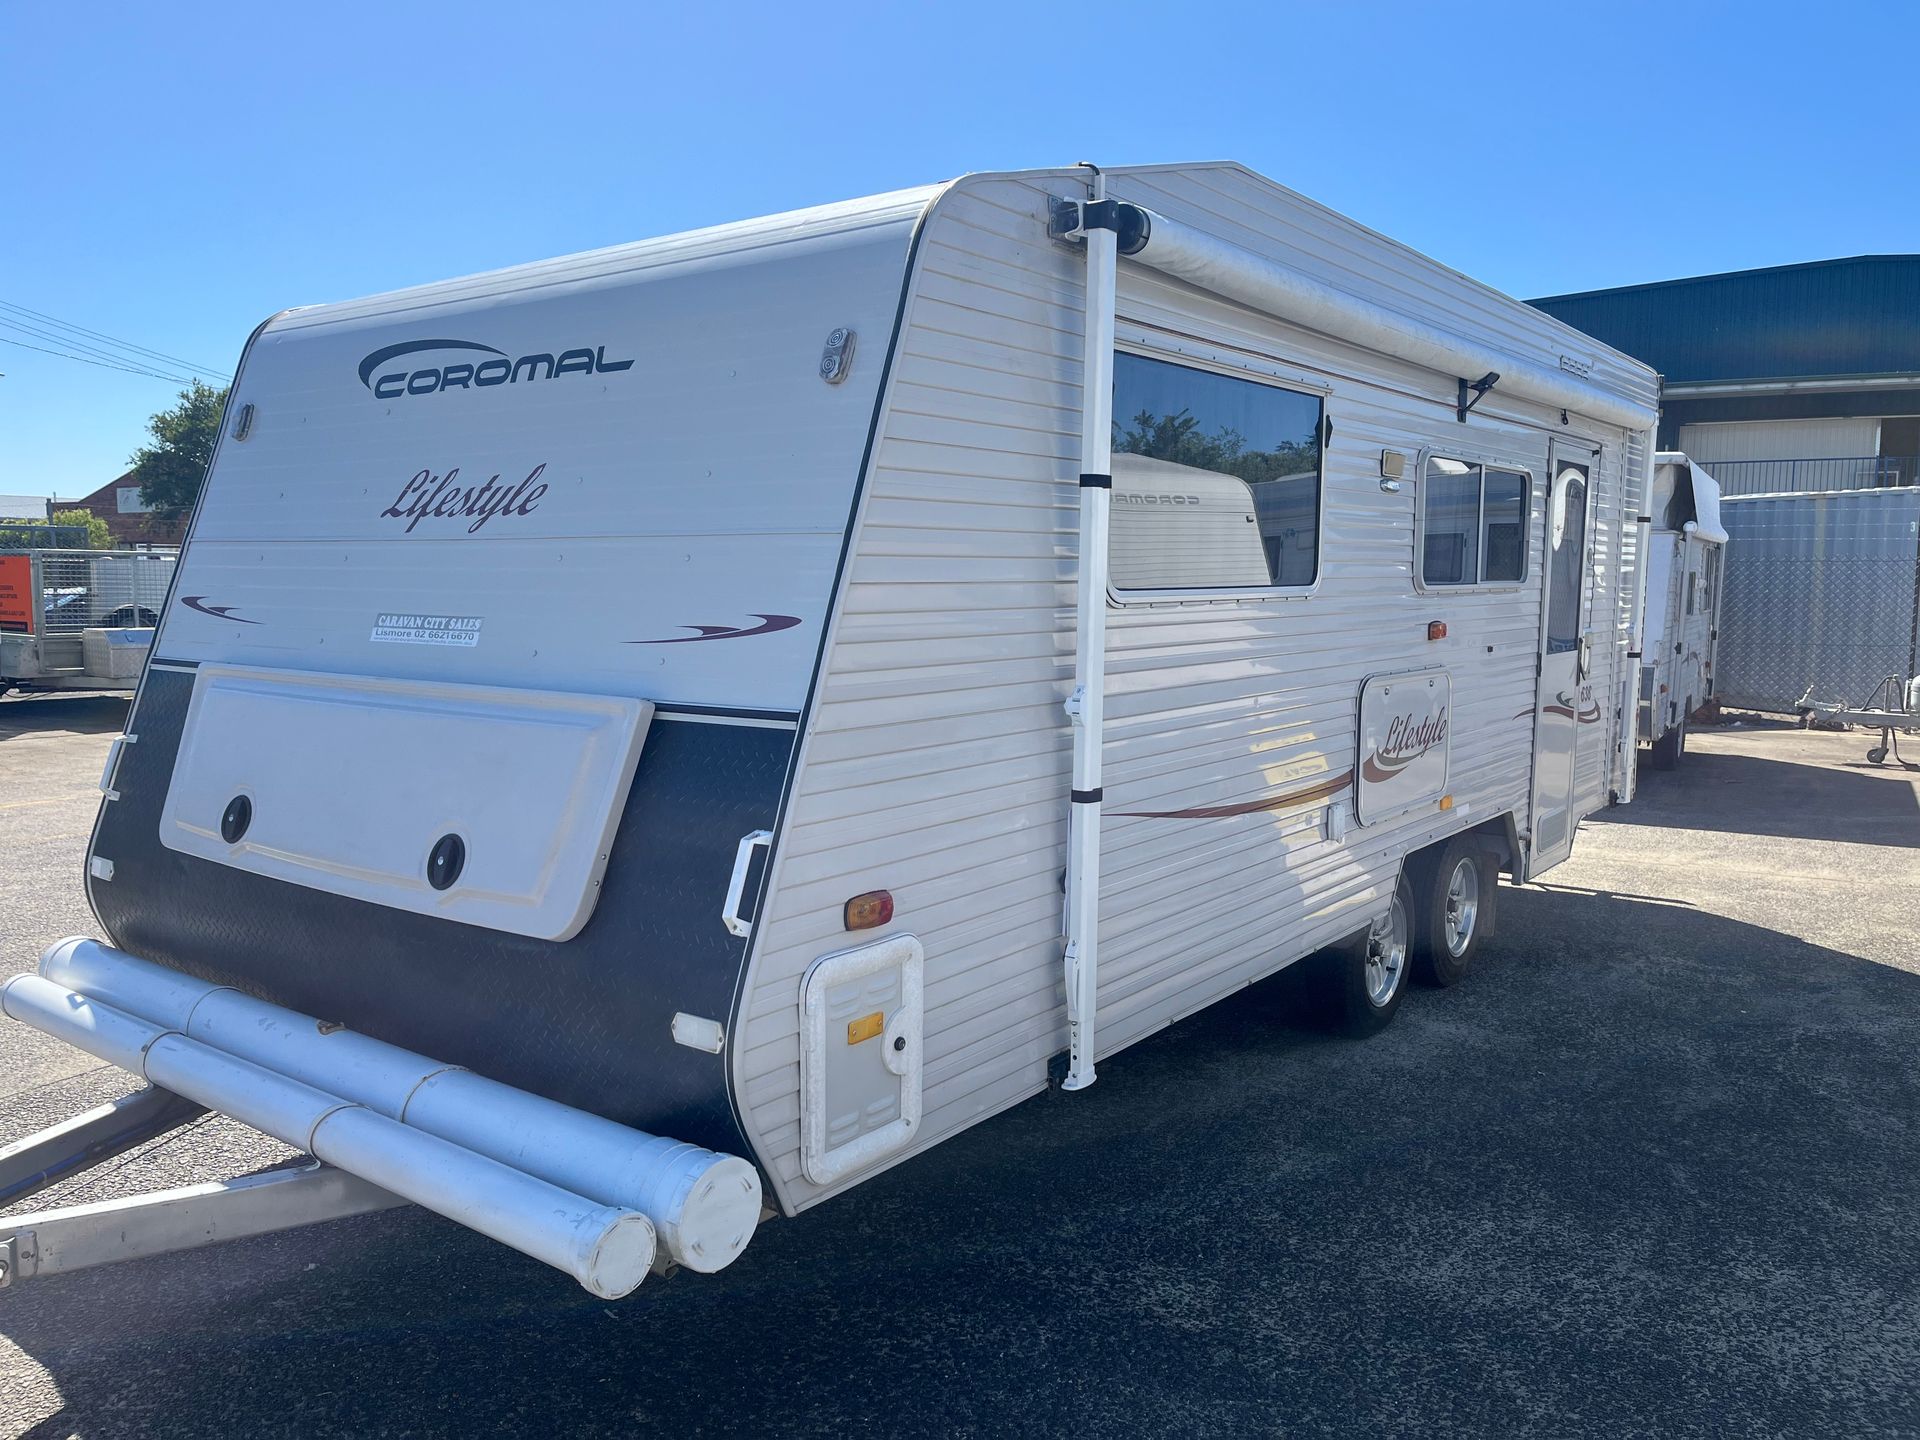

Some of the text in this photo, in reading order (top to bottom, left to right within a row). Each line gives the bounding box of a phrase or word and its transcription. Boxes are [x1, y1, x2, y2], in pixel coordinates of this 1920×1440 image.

[374, 345, 635, 400] COROMAL
[380, 462, 549, 534] Lifestyle
[375, 628, 475, 641] Lismore 02 66216670
[378, 615, 481, 630] CARAVAN CITY SALES
[1382, 706, 1448, 758] Lifestyle
